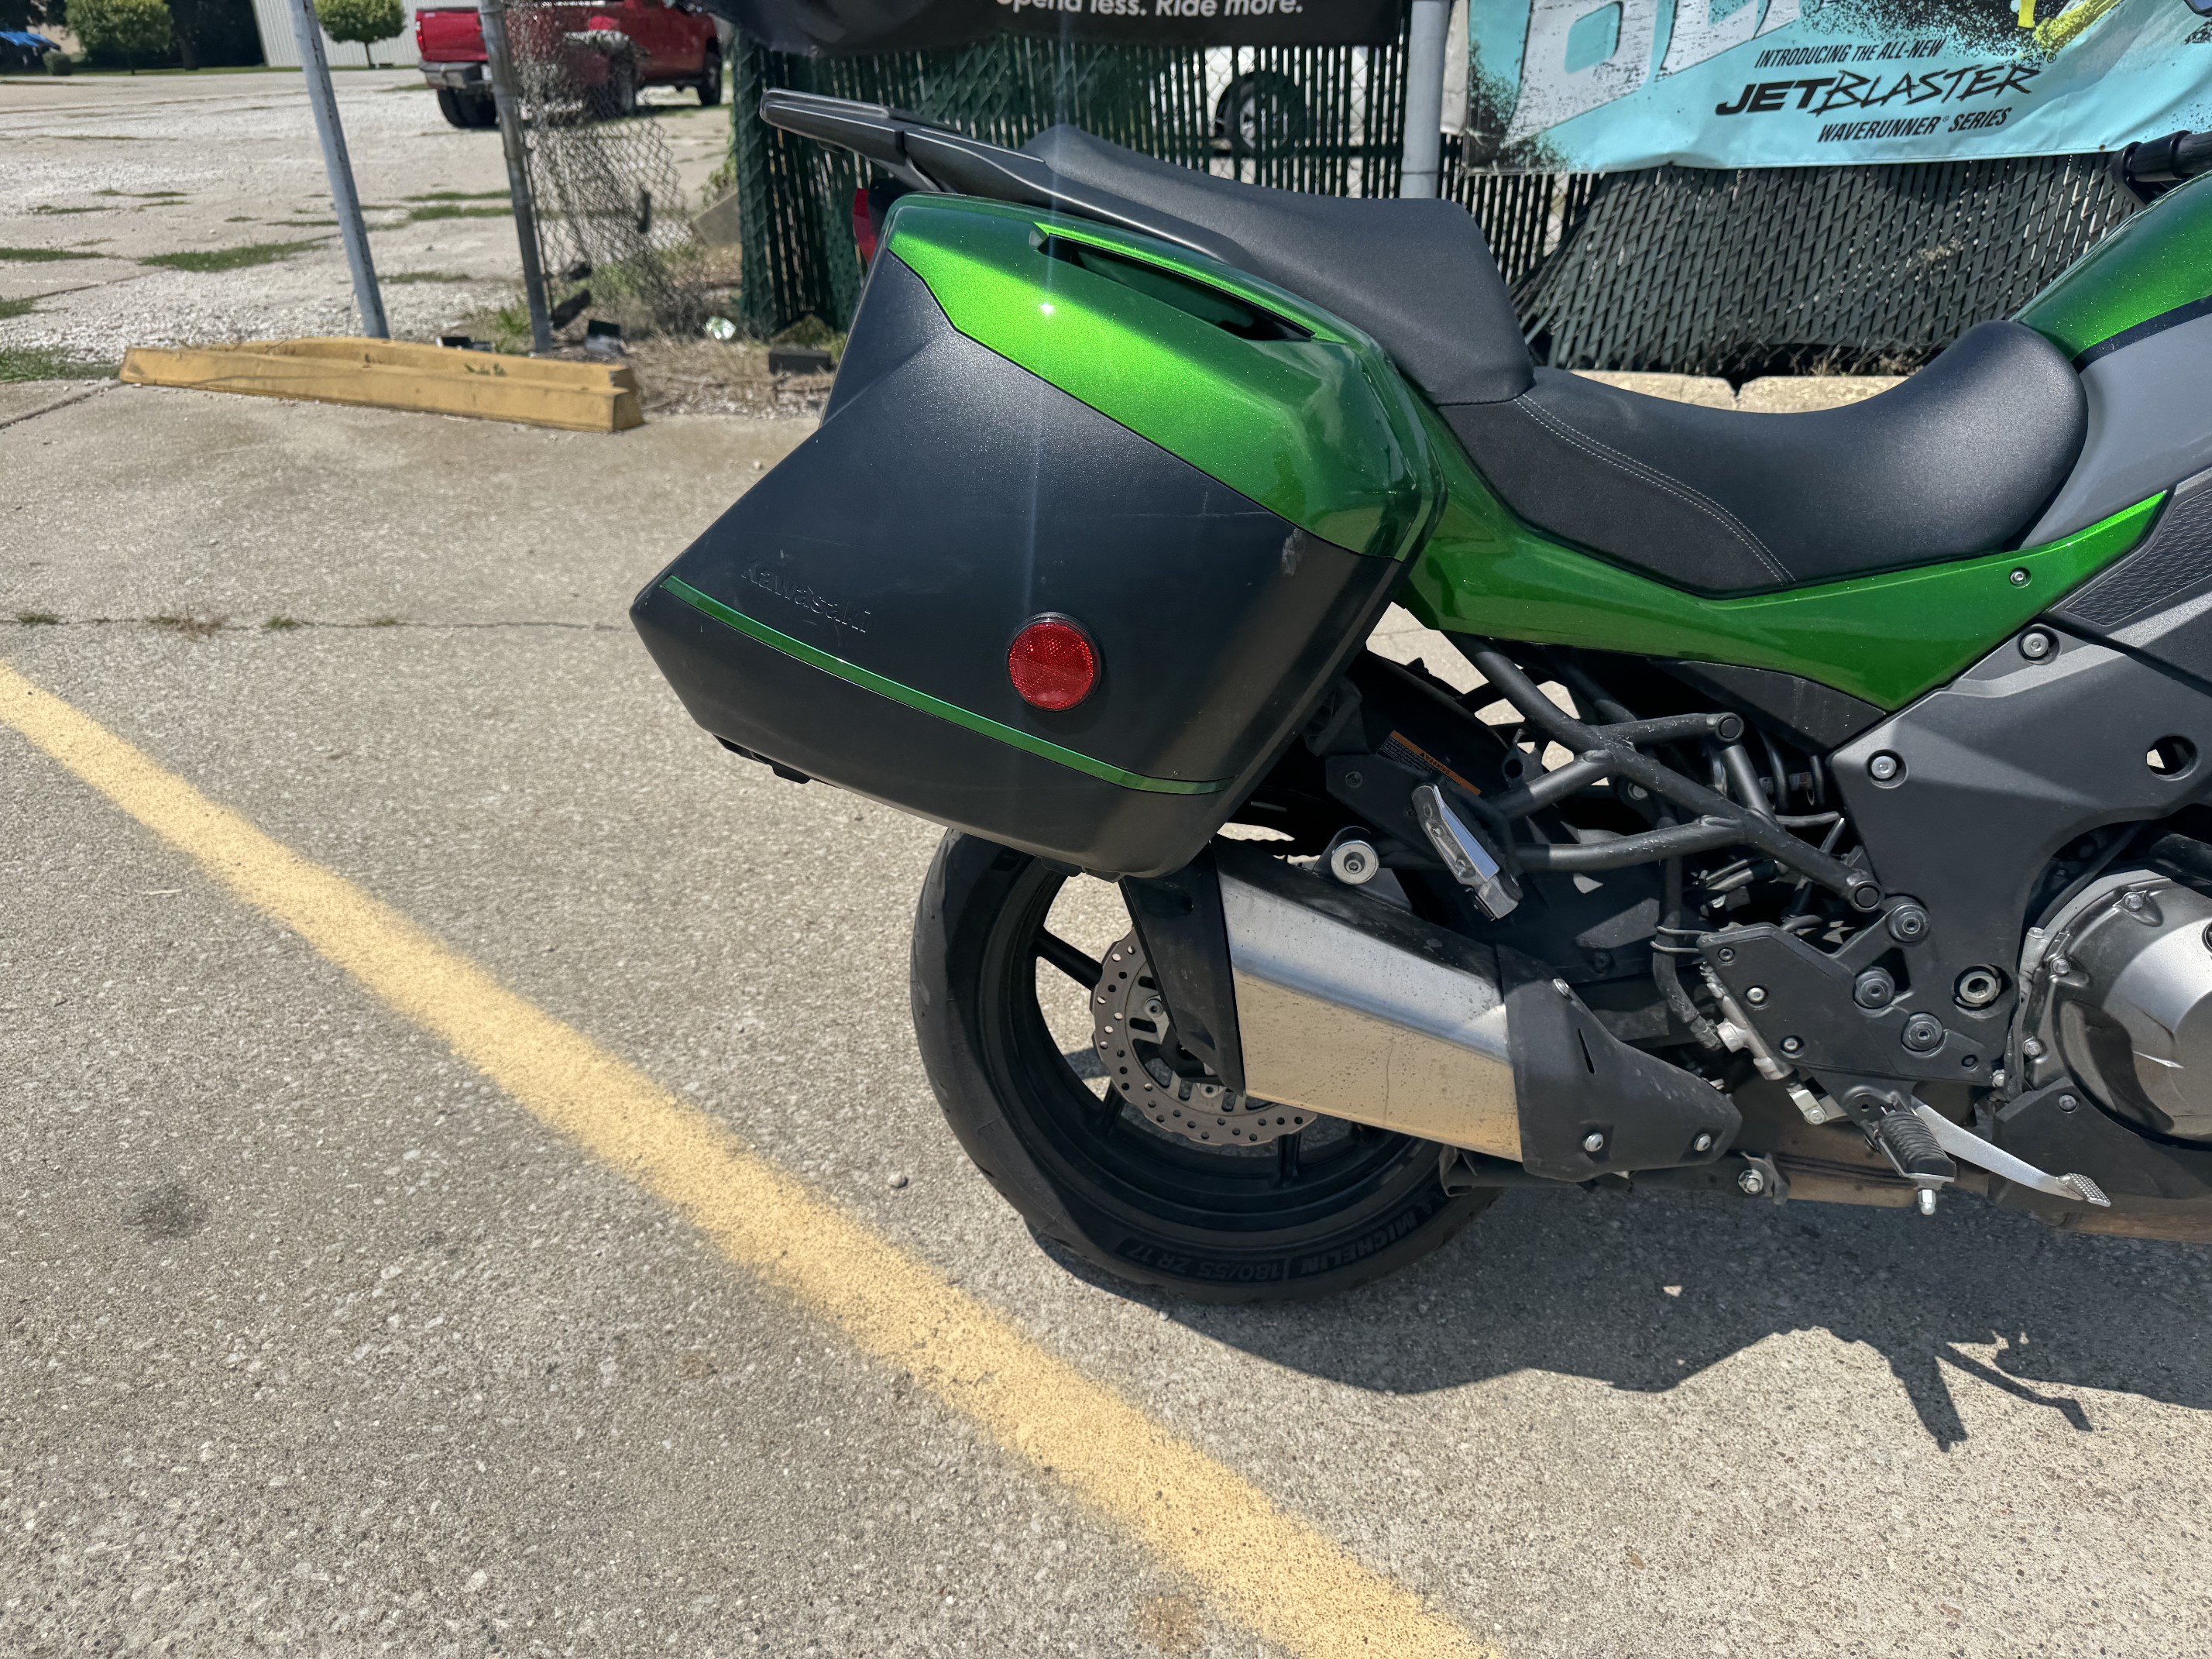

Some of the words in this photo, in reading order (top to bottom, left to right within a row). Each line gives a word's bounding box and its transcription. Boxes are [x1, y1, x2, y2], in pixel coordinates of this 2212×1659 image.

[1090, 0, 1148, 16] less.
[1155, 0, 1218, 17] Ride
[1224, 0, 1304, 16] more.
[1754, 44, 1853, 68] INTRODUCING
[1851, 45, 1879, 62] THE
[1876, 38, 1946, 60] ALL-NEW
[1948, 107, 2013, 133] SERIES
[1125, 1245, 1151, 1263] 17
[1300, 1214, 1418, 1275] MICHELIN
[1160, 1252, 1193, 1274] ZR
[1200, 1259, 1283, 1281] 180/55
